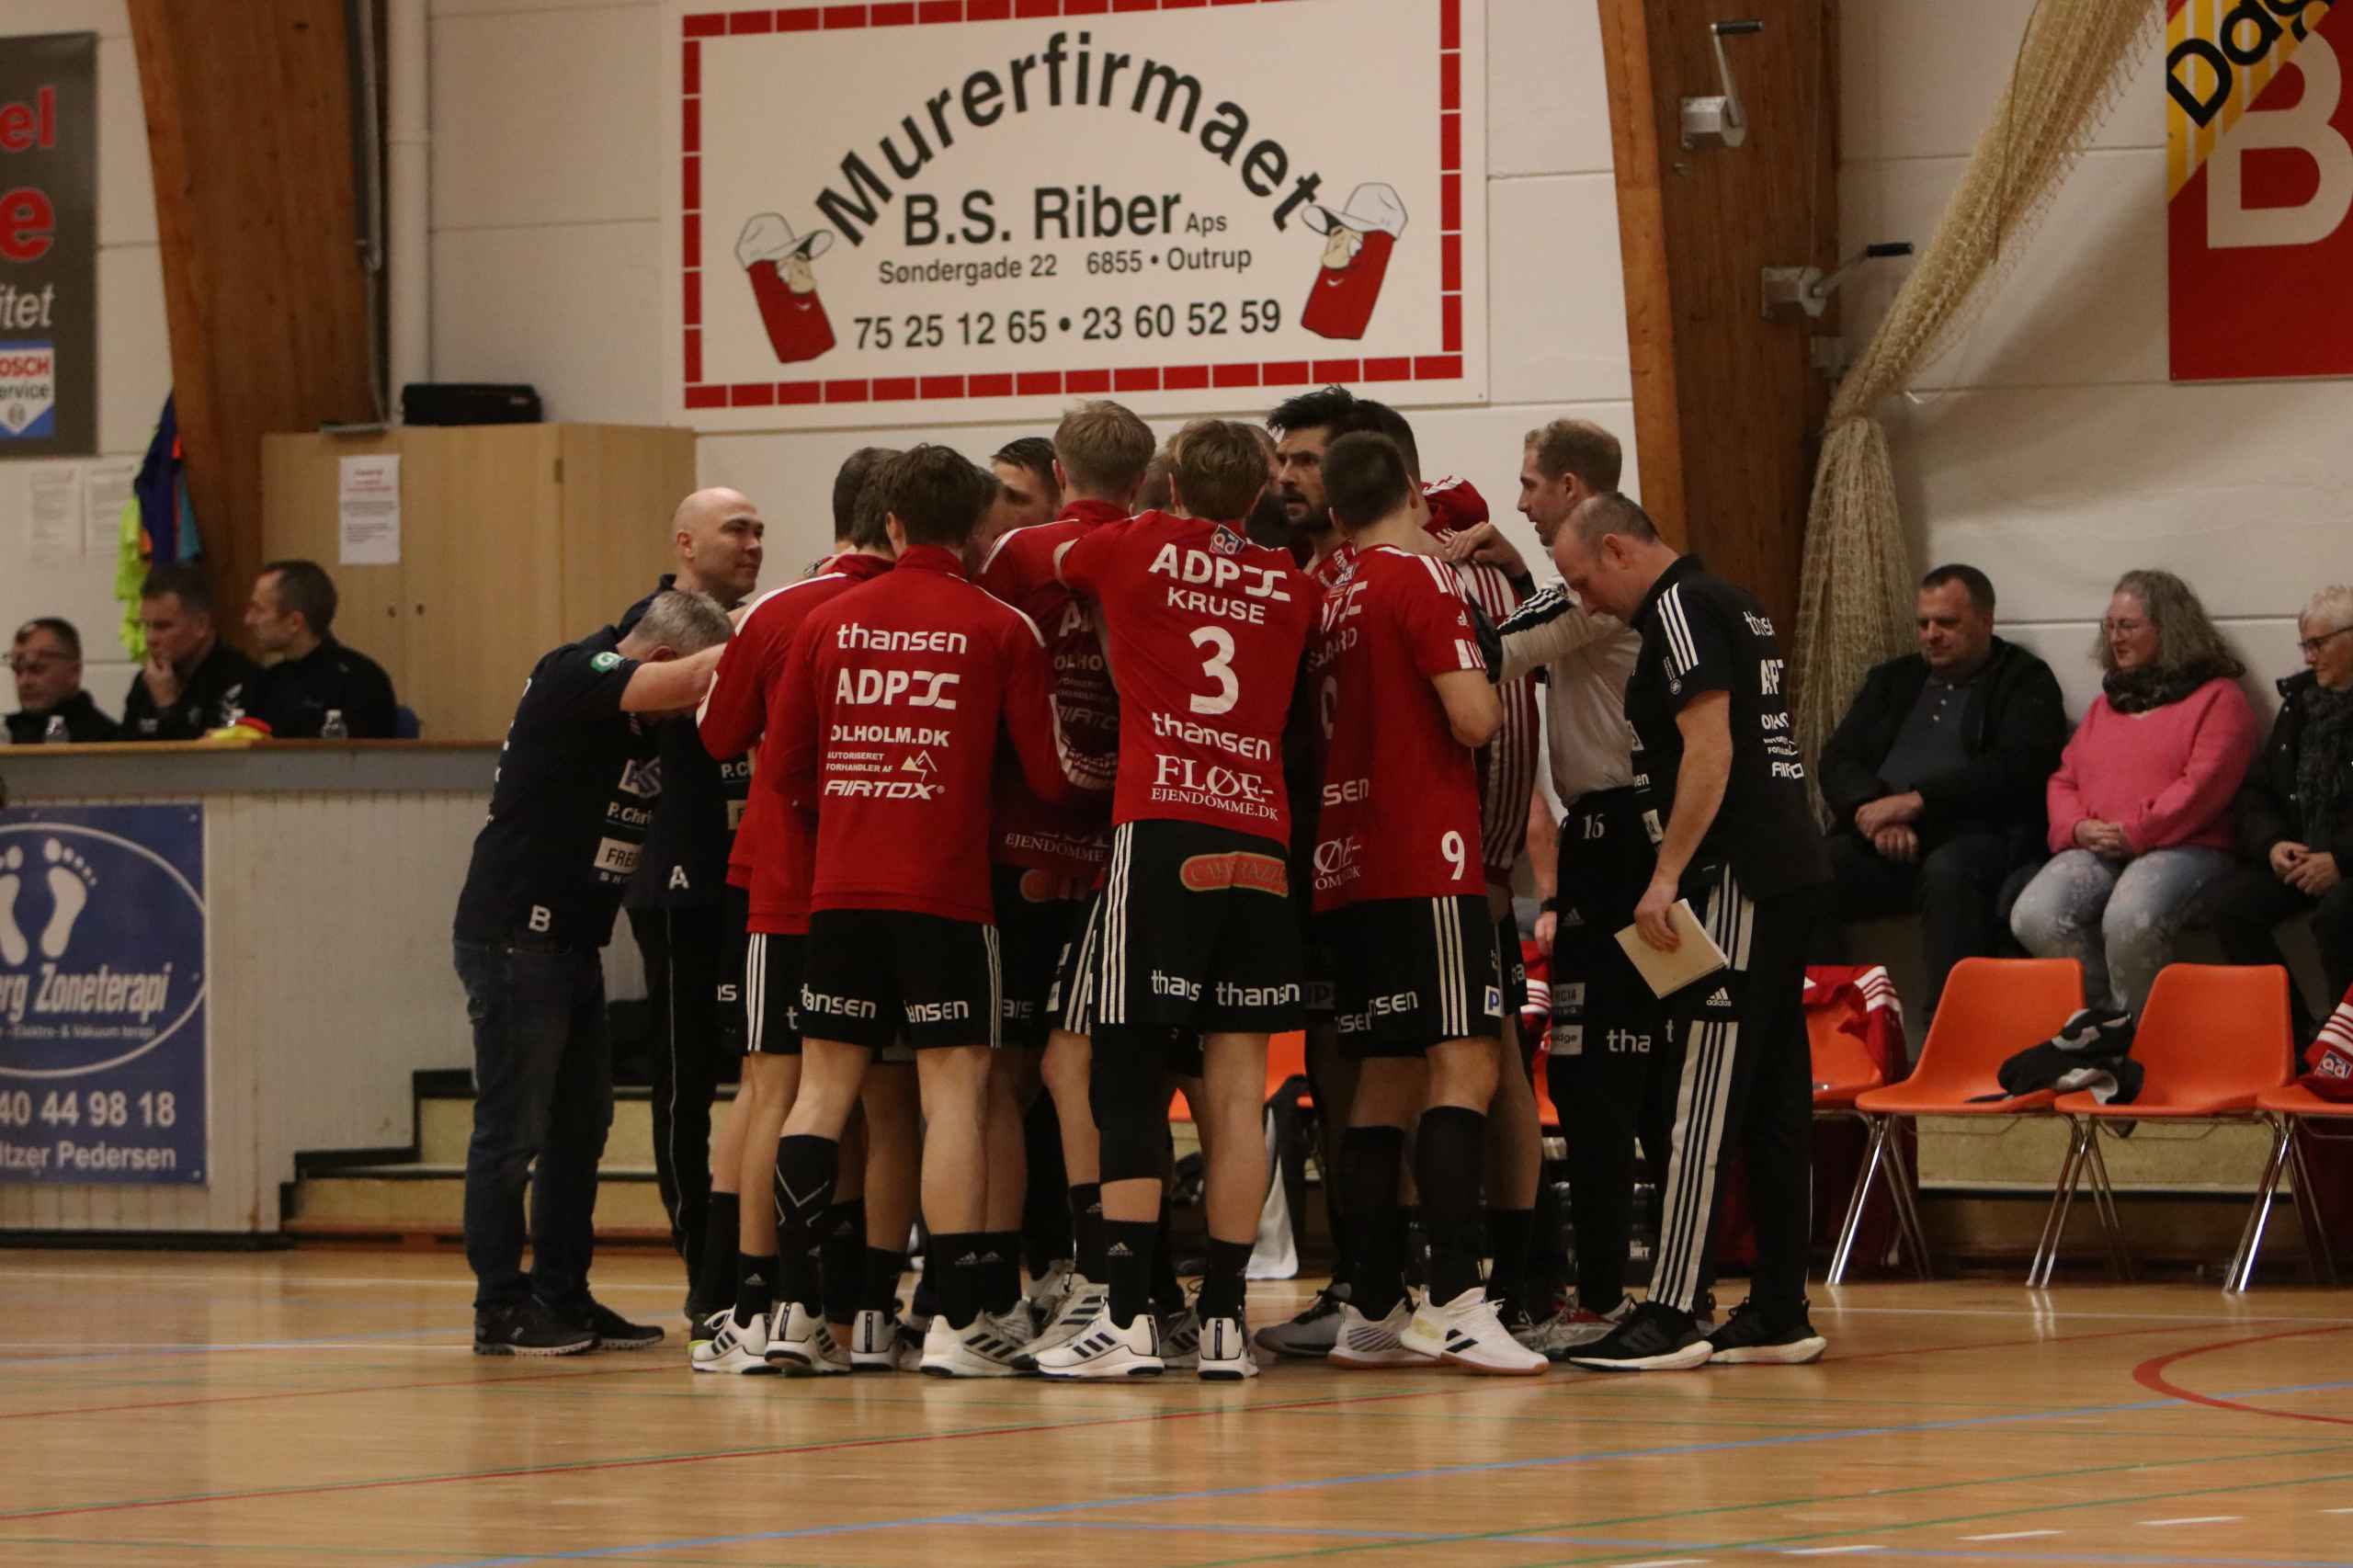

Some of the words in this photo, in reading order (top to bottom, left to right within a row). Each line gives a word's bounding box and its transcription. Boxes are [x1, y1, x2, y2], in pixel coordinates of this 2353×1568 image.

[814, 31, 1322, 246] Murerfirmaet
[904, 190, 1012, 246] B.S.
[1034, 187, 1182, 240] Riber
[1185, 212, 1227, 237] Aps
[879, 257, 1022, 287] Søndergade
[1029, 255, 1057, 278] 22
[1086, 249, 1142, 275] 6855
[1166, 246, 1253, 278] Outrup
[854, 318, 892, 350] 75
[904, 315, 944, 347] 25
[958, 313, 996, 346] 12
[1007, 312, 1046, 343] 65
[1083, 307, 1123, 340] 23
[1134, 304, 1175, 337] 60
[1188, 301, 1228, 336] 52
[1240, 300, 1281, 334] 59
[1149, 542, 1241, 589] ADP
[1166, 586, 1267, 626] KRUSE
[836, 622, 968, 654] thansen
[835, 666, 910, 705] ADP
[1188, 625, 1240, 715] 3
[1152, 711, 1272, 763] thansen
[824, 779, 938, 801] AIRTOX
[1151, 785, 1279, 823] EJENDOMME.DK
[1440, 830, 1466, 881] 9
[668, 865, 689, 890] A
[528, 904, 552, 933] B
[35, 961, 173, 1022] Zoneterapi
[40, 1092, 80, 1127] 44
[88, 1091, 128, 1127] 98
[139, 1091, 176, 1127] 18
[57, 1141, 176, 1170] Pedersen
